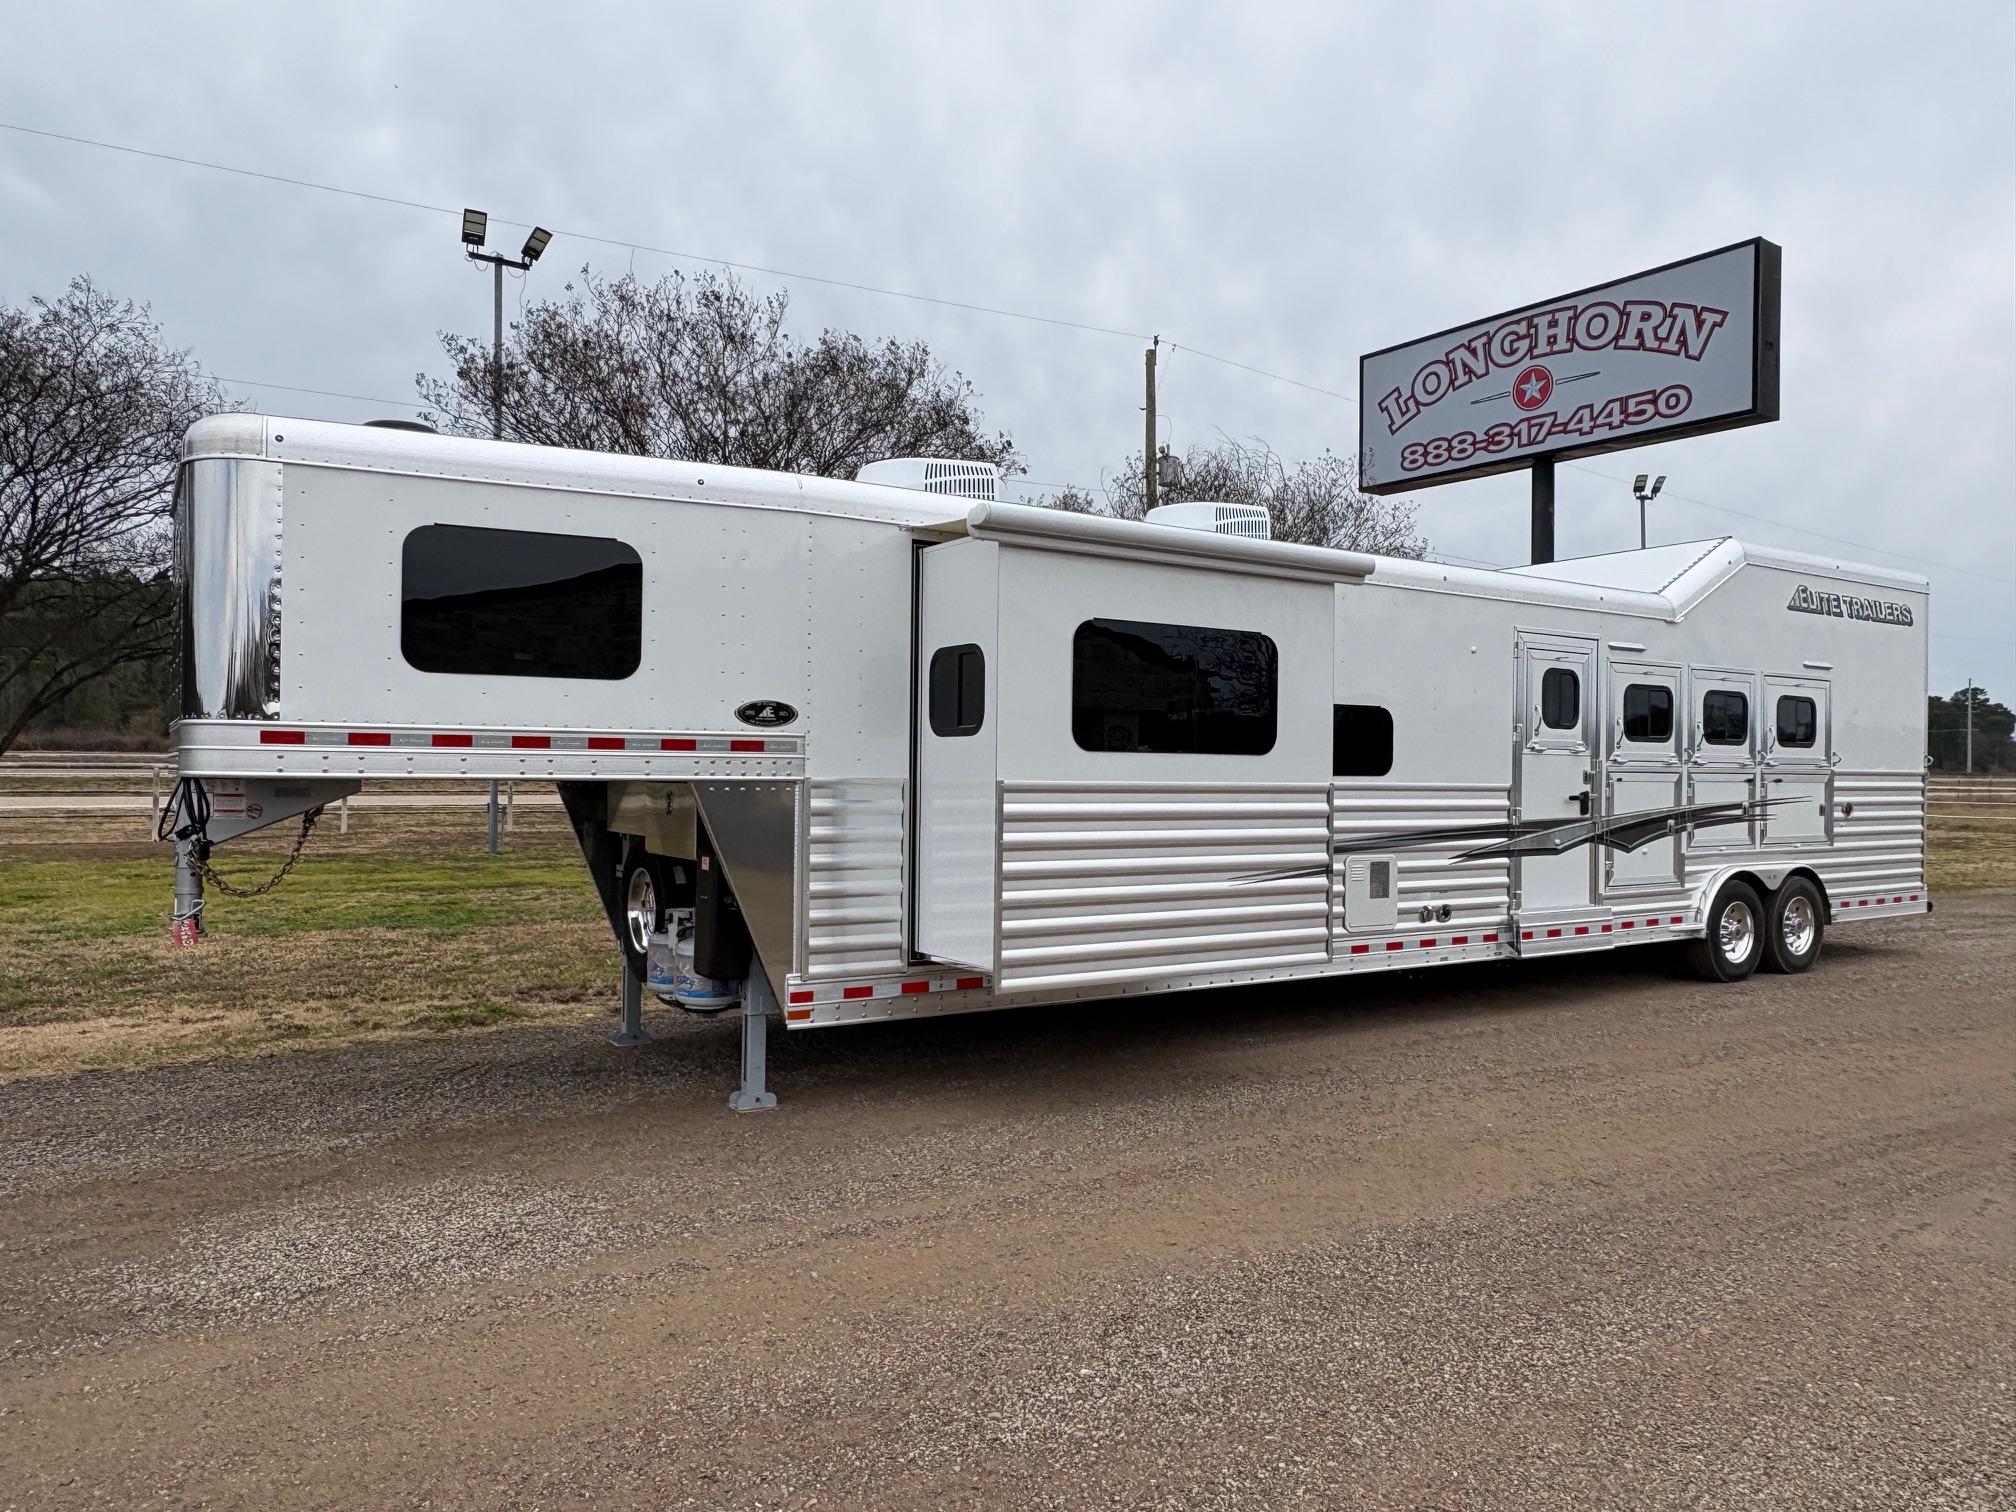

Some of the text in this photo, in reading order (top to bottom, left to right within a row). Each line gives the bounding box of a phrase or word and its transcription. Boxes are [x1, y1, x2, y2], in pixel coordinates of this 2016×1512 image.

[1378, 300, 1729, 436] LONGHORN
[1400, 384, 1693, 472] 888-317-4450
[1842, 595, 1914, 627] TRAILERS
